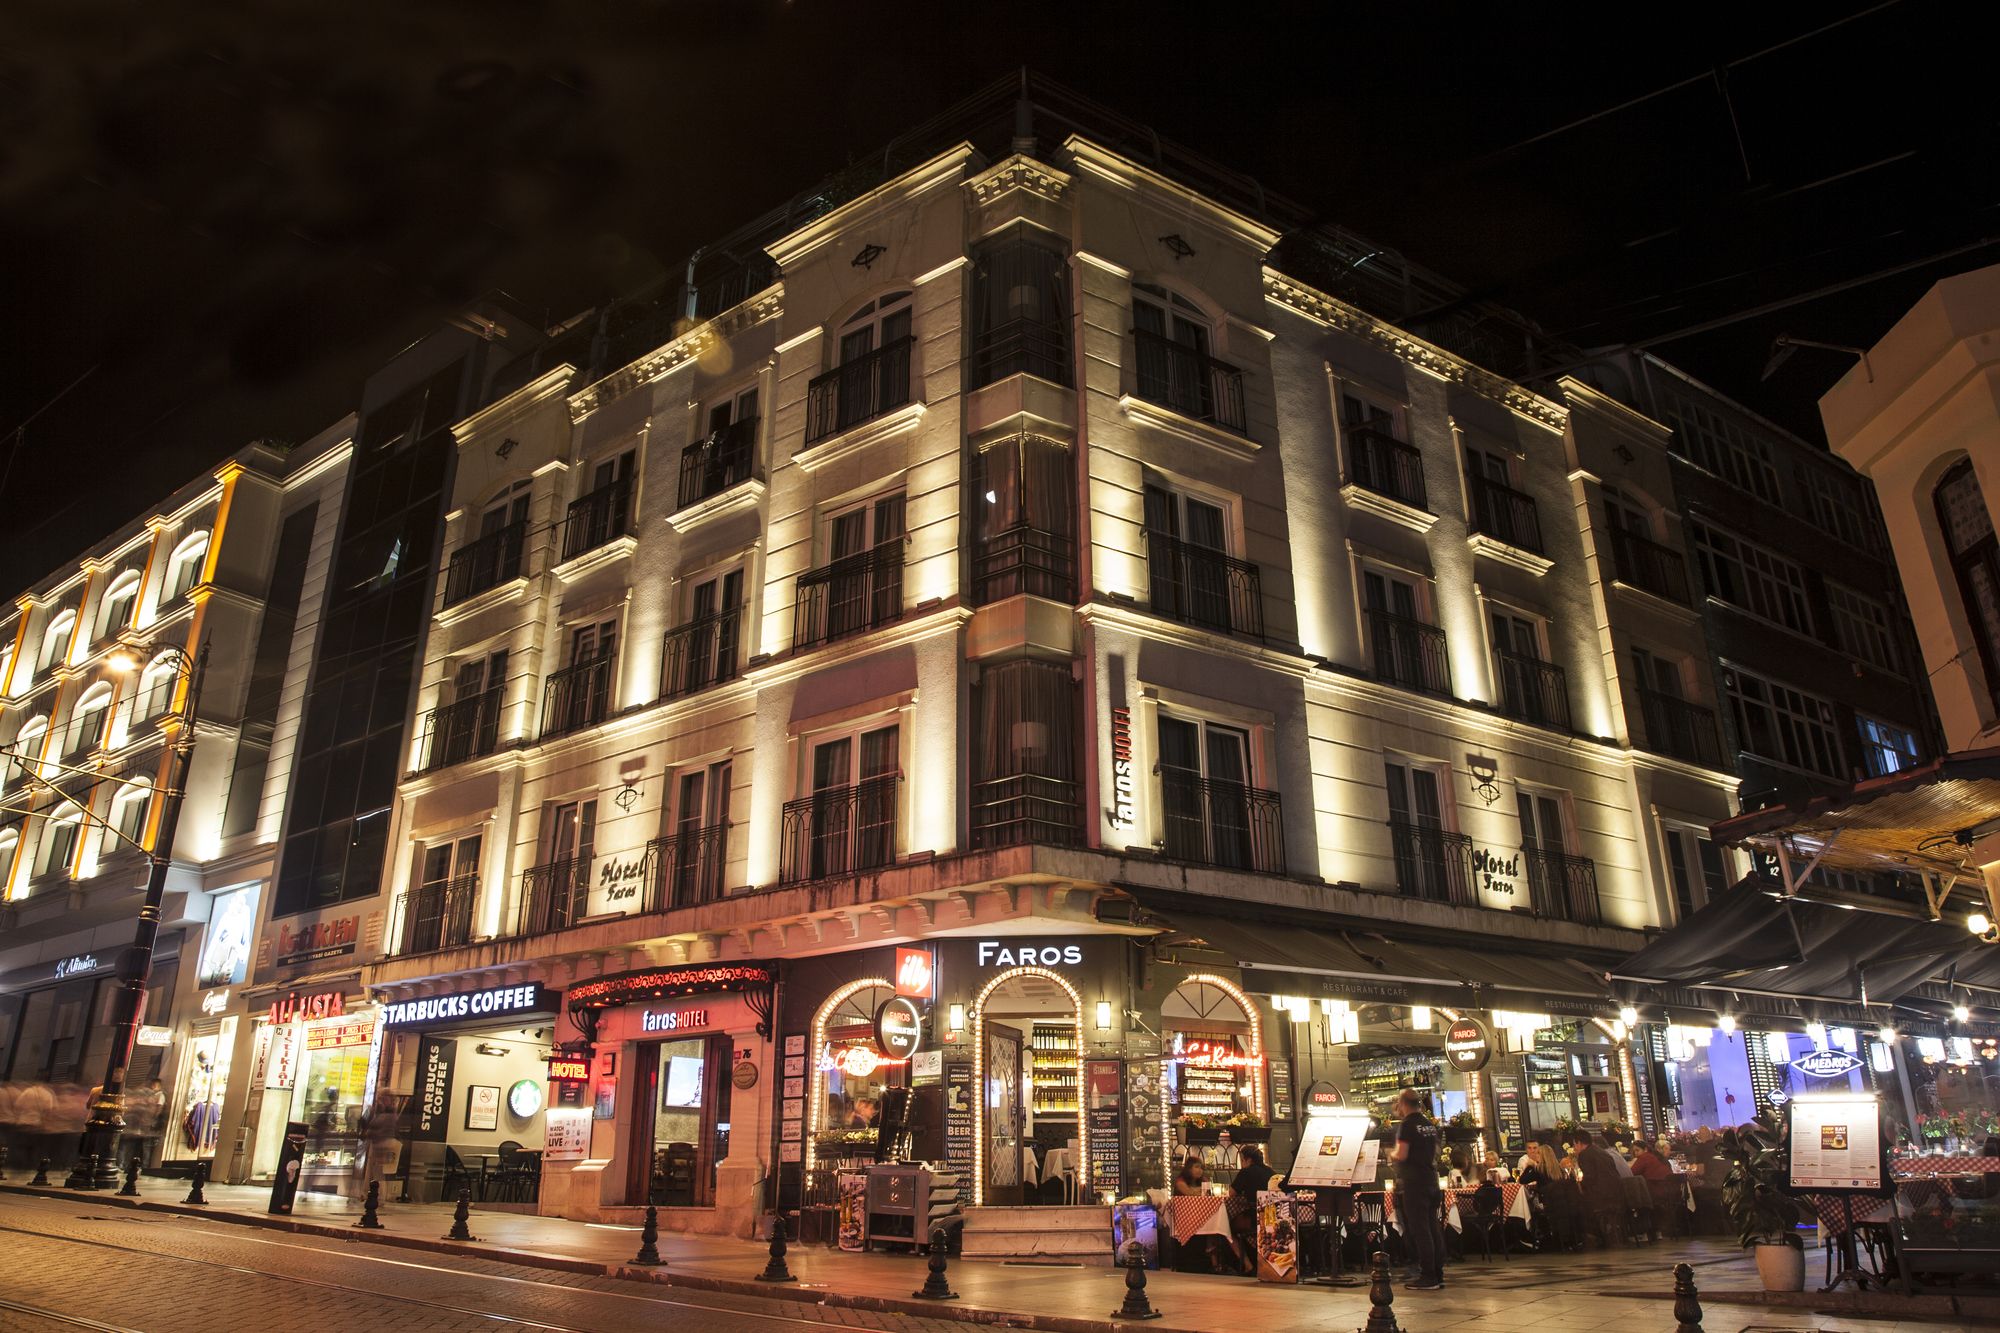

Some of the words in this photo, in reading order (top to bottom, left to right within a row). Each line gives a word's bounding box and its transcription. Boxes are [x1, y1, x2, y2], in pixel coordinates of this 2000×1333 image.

[600, 856, 646, 886] Hotel
[1474, 848, 1519, 877] Hotel
[606, 883, 637, 902] Faros
[1483, 873, 1514, 895] Faros
[978, 941, 1082, 967] FAROS
[898, 954, 932, 993] illy
[1322, 982, 1378, 995] RESTAURANT
[300, 992, 344, 1021] USTA
[379, 995, 468, 1025] STARBUCKS
[471, 985, 535, 1014] COFFEE
[1453, 1029, 1477, 1040] FAROS
[551, 1061, 589, 1079] HOTEL
[421, 1045, 440, 1131] STARBUCKS
[433, 1061, 448, 1115] COFFEE
[1314, 1093, 1337, 1102] FAROS
[947, 1126, 971, 1136] BEER
[548, 1138, 563, 1147] LIVE
[947, 1149, 971, 1158] WINE
[1092, 1152, 1119, 1161] MEZES
